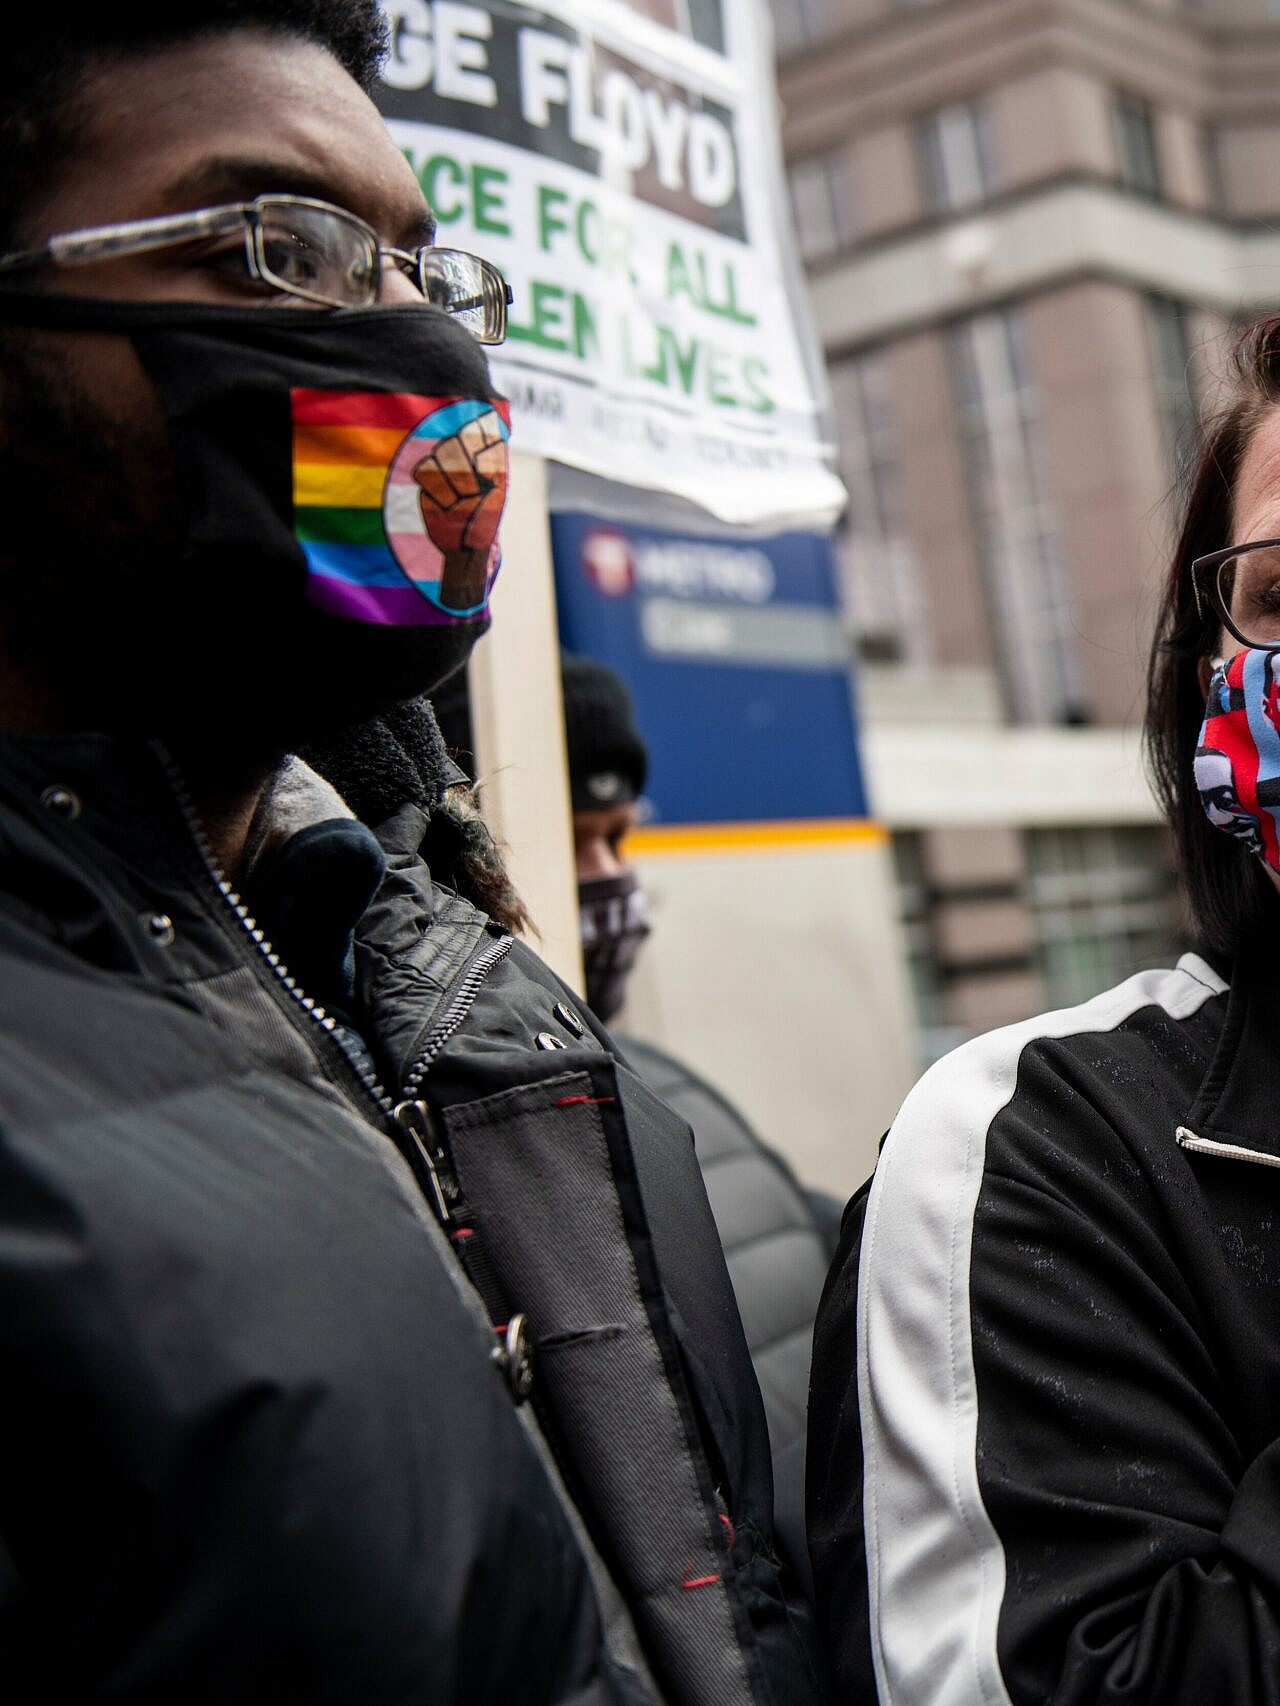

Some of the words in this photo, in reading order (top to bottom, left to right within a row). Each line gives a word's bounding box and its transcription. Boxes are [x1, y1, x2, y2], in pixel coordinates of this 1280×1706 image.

[517, 27, 736, 208] FLOYD
[402, 146, 511, 235] CE
[666, 241, 758, 327] ALL
[622, 306, 777, 416] LIVES
